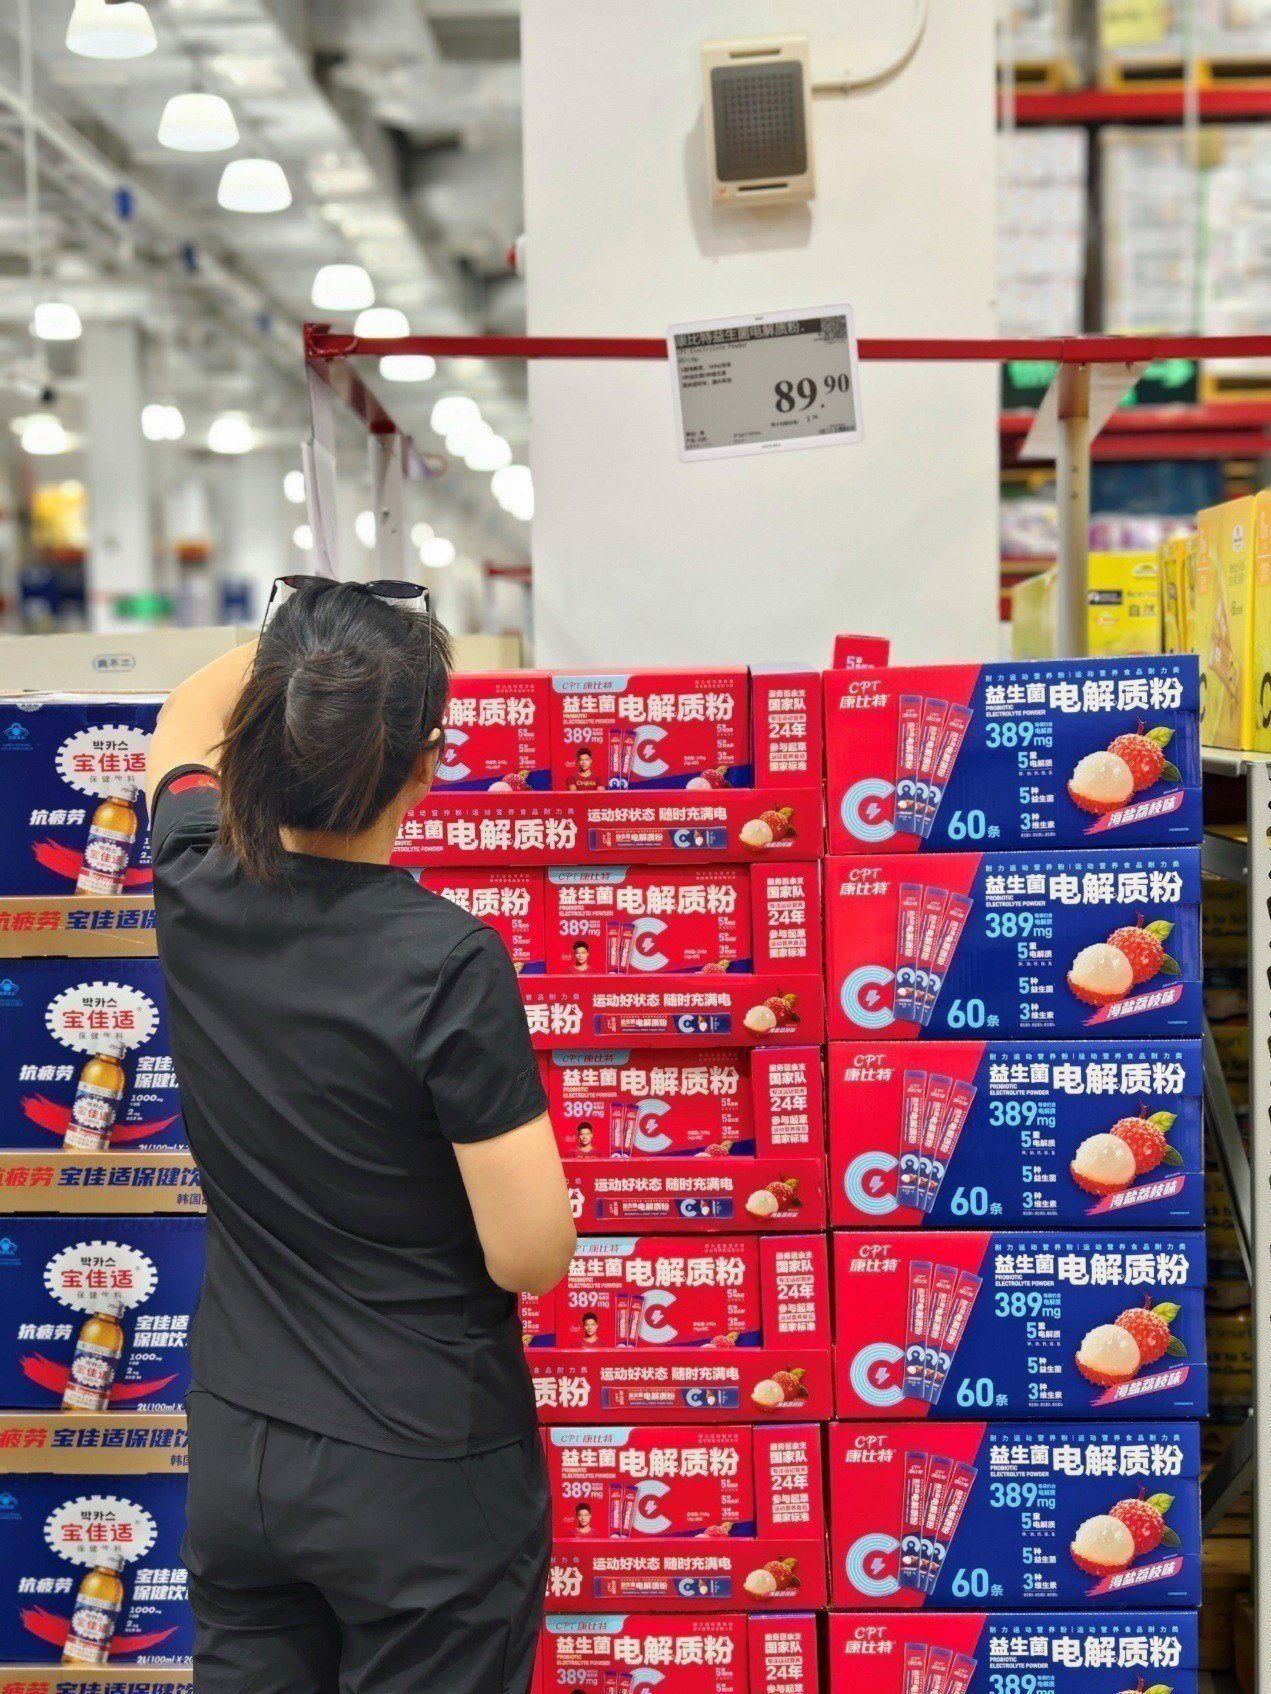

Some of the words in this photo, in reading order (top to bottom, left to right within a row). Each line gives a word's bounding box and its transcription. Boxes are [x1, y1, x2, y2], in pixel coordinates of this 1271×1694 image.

[849, 680, 882, 694] CPT
[985, 682, 1046, 704] 益生菌
[1050, 677, 1184, 713] 电解质粉
[618, 692, 735, 723] 电解质粉
[839, 694, 890, 709] 康比特
[769, 722, 807, 739] 24年
[93, 740, 129, 751] 박카스
[72, 753, 147, 773] 宝佳适
[29, 809, 86, 826] 抗疲劳
[447, 818, 578, 851] 电解质粉
[849, 868, 882, 882] CPT
[839, 882, 889, 896] 康比特
[985, 874, 1046, 895] 益生菌
[1049, 870, 1183, 905] 电解质粉
[616, 885, 737, 915] 电解质粉
[767, 910, 806, 926] 24年
[82, 997, 118, 1008] 박카스
[62, 1010, 135, 1030] 宝佳适
[853, 1054, 886, 1067] CPT
[19, 1065, 75, 1082] 抗疲劳
[620, 1066, 740, 1097] 电解质粉
[843, 1067, 894, 1082] 康比特
[989, 1063, 1049, 1084] 益生菌
[1053, 1062, 1186, 1095] 电解质粉
[770, 1096, 808, 1112] 24年
[859, 1244, 892, 1259] CPT
[80, 1256, 116, 1267] 박카스
[850, 1258, 900, 1273] 康比特
[995, 1254, 1054, 1274] 益生菌
[1058, 1253, 1190, 1286] 电解质粉
[60, 1269, 134, 1289] 宝佳适
[625, 1256, 745, 1287] 电解质粉
[777, 1284, 815, 1300] 24年
[18, 1324, 73, 1341] 抗疲劳
[854, 1435, 887, 1449] CPT
[619, 1447, 740, 1478] 电解质粉
[845, 1449, 895, 1463] 康比特
[989, 1445, 1049, 1465] 益生菌
[1053, 1443, 1184, 1477] 电解质粉
[771, 1475, 809, 1491] 24年
[80, 1511, 116, 1522] 박카스
[61, 1523, 133, 1543] 宝佳适
[18, 1577, 74, 1594] 抗疲劳
[853, 1626, 887, 1640] CPT
[613, 1634, 734, 1666] 电解质粉
[845, 1640, 895, 1654] 康比特
[989, 1636, 1048, 1657] 益生菌
[1052, 1635, 1183, 1668] 电解质粉
[765, 1665, 804, 1681] 24年
